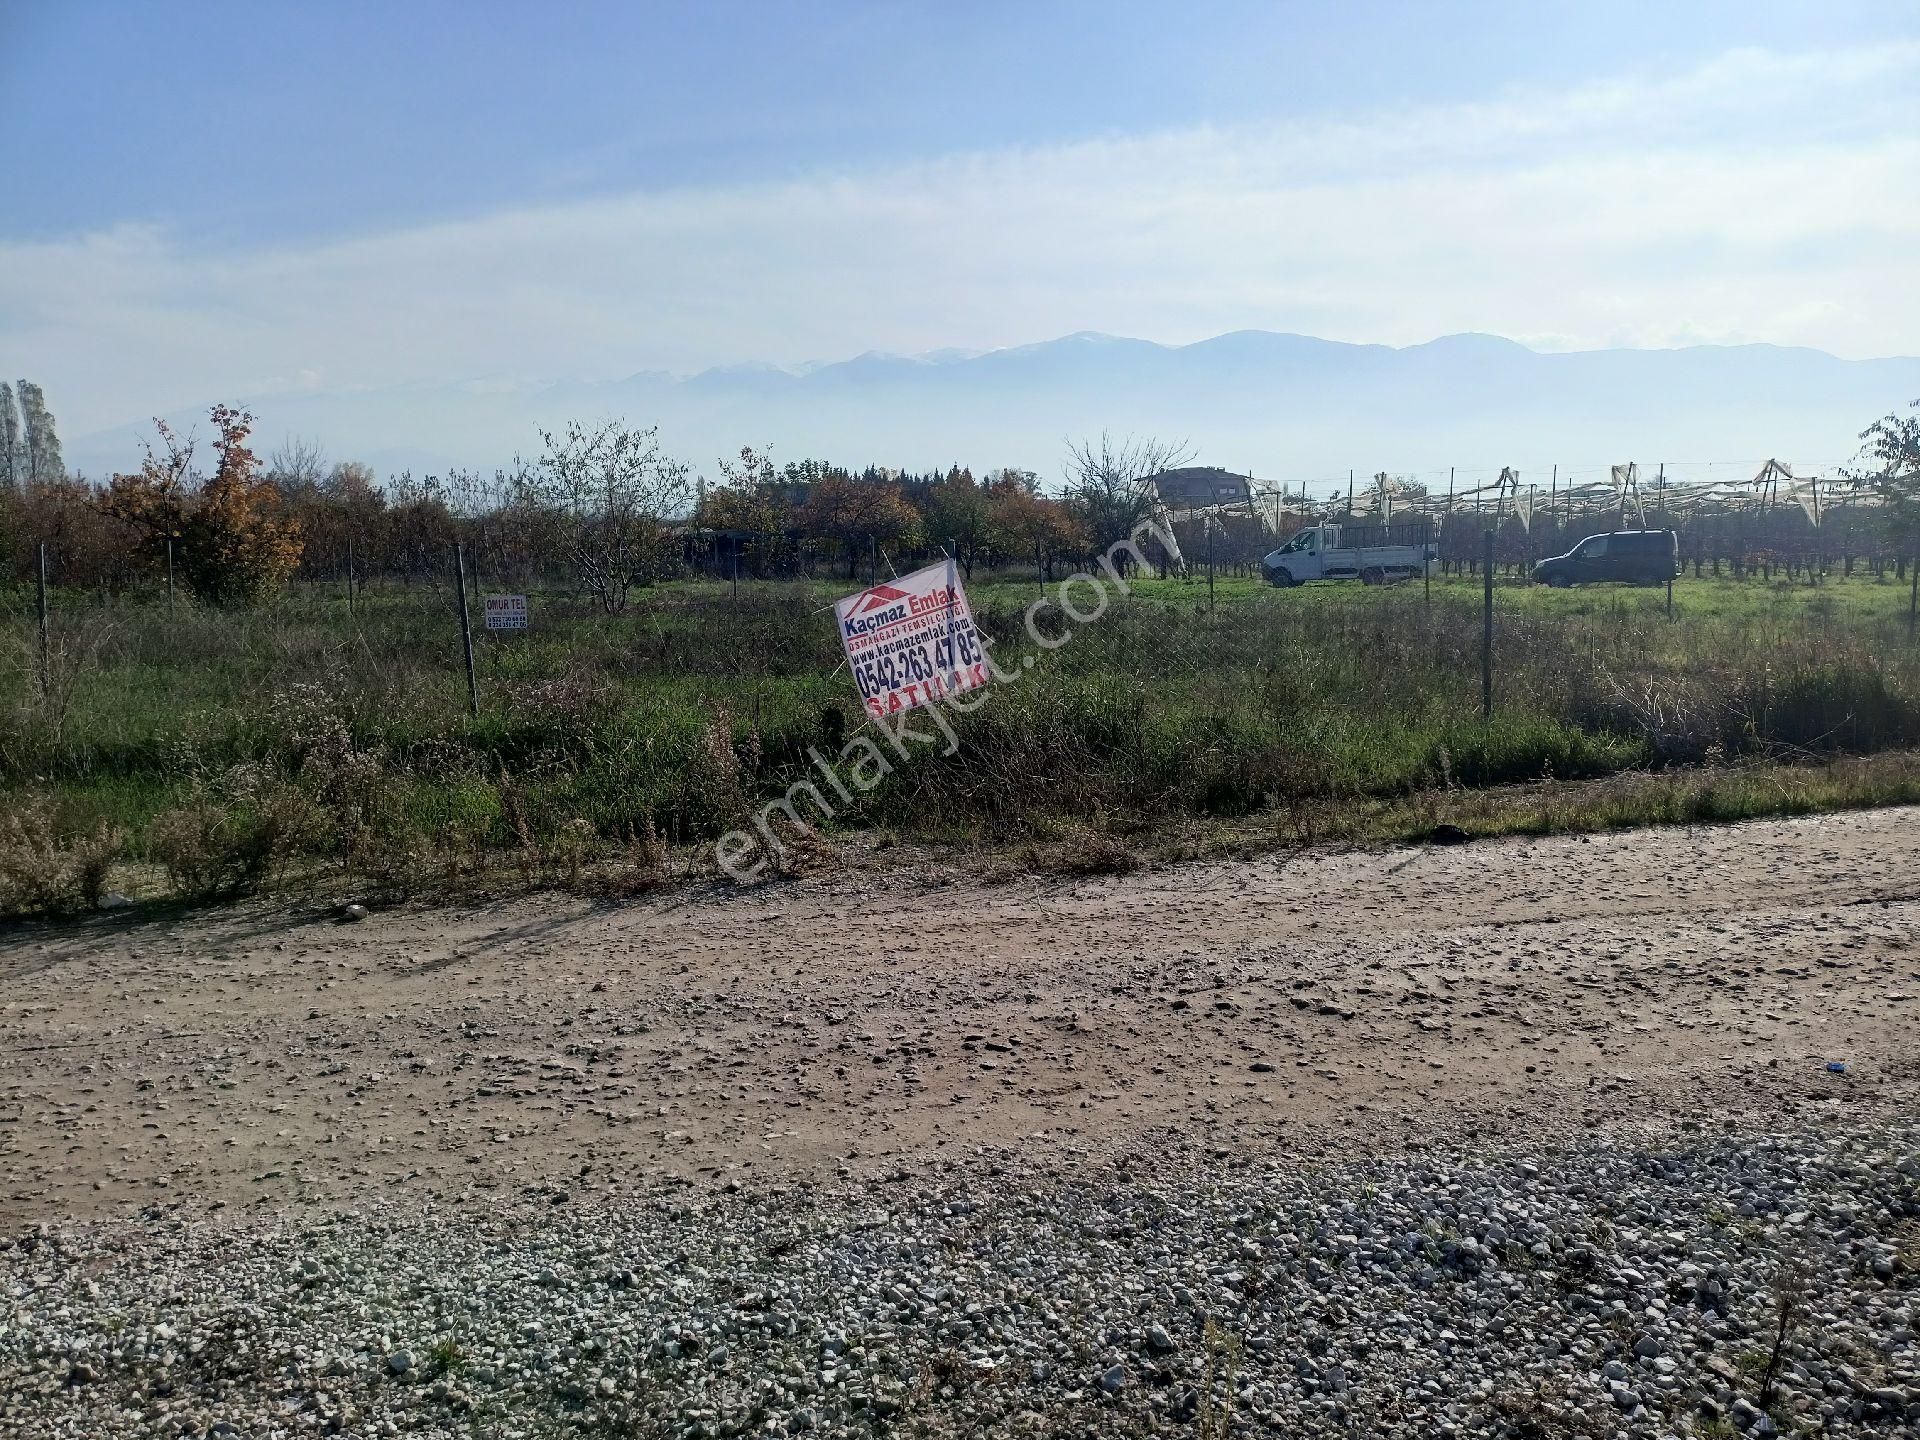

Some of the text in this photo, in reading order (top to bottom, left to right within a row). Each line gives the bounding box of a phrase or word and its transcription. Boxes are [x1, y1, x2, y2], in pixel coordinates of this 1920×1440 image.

[511, 599, 526, 610] TEL
[844, 584, 960, 637] Kaçmaz Emlak
[850, 617, 970, 667] www.kacmazemlak.com
[935, 636, 955, 671] 47
[956, 628, 982, 666] 85
